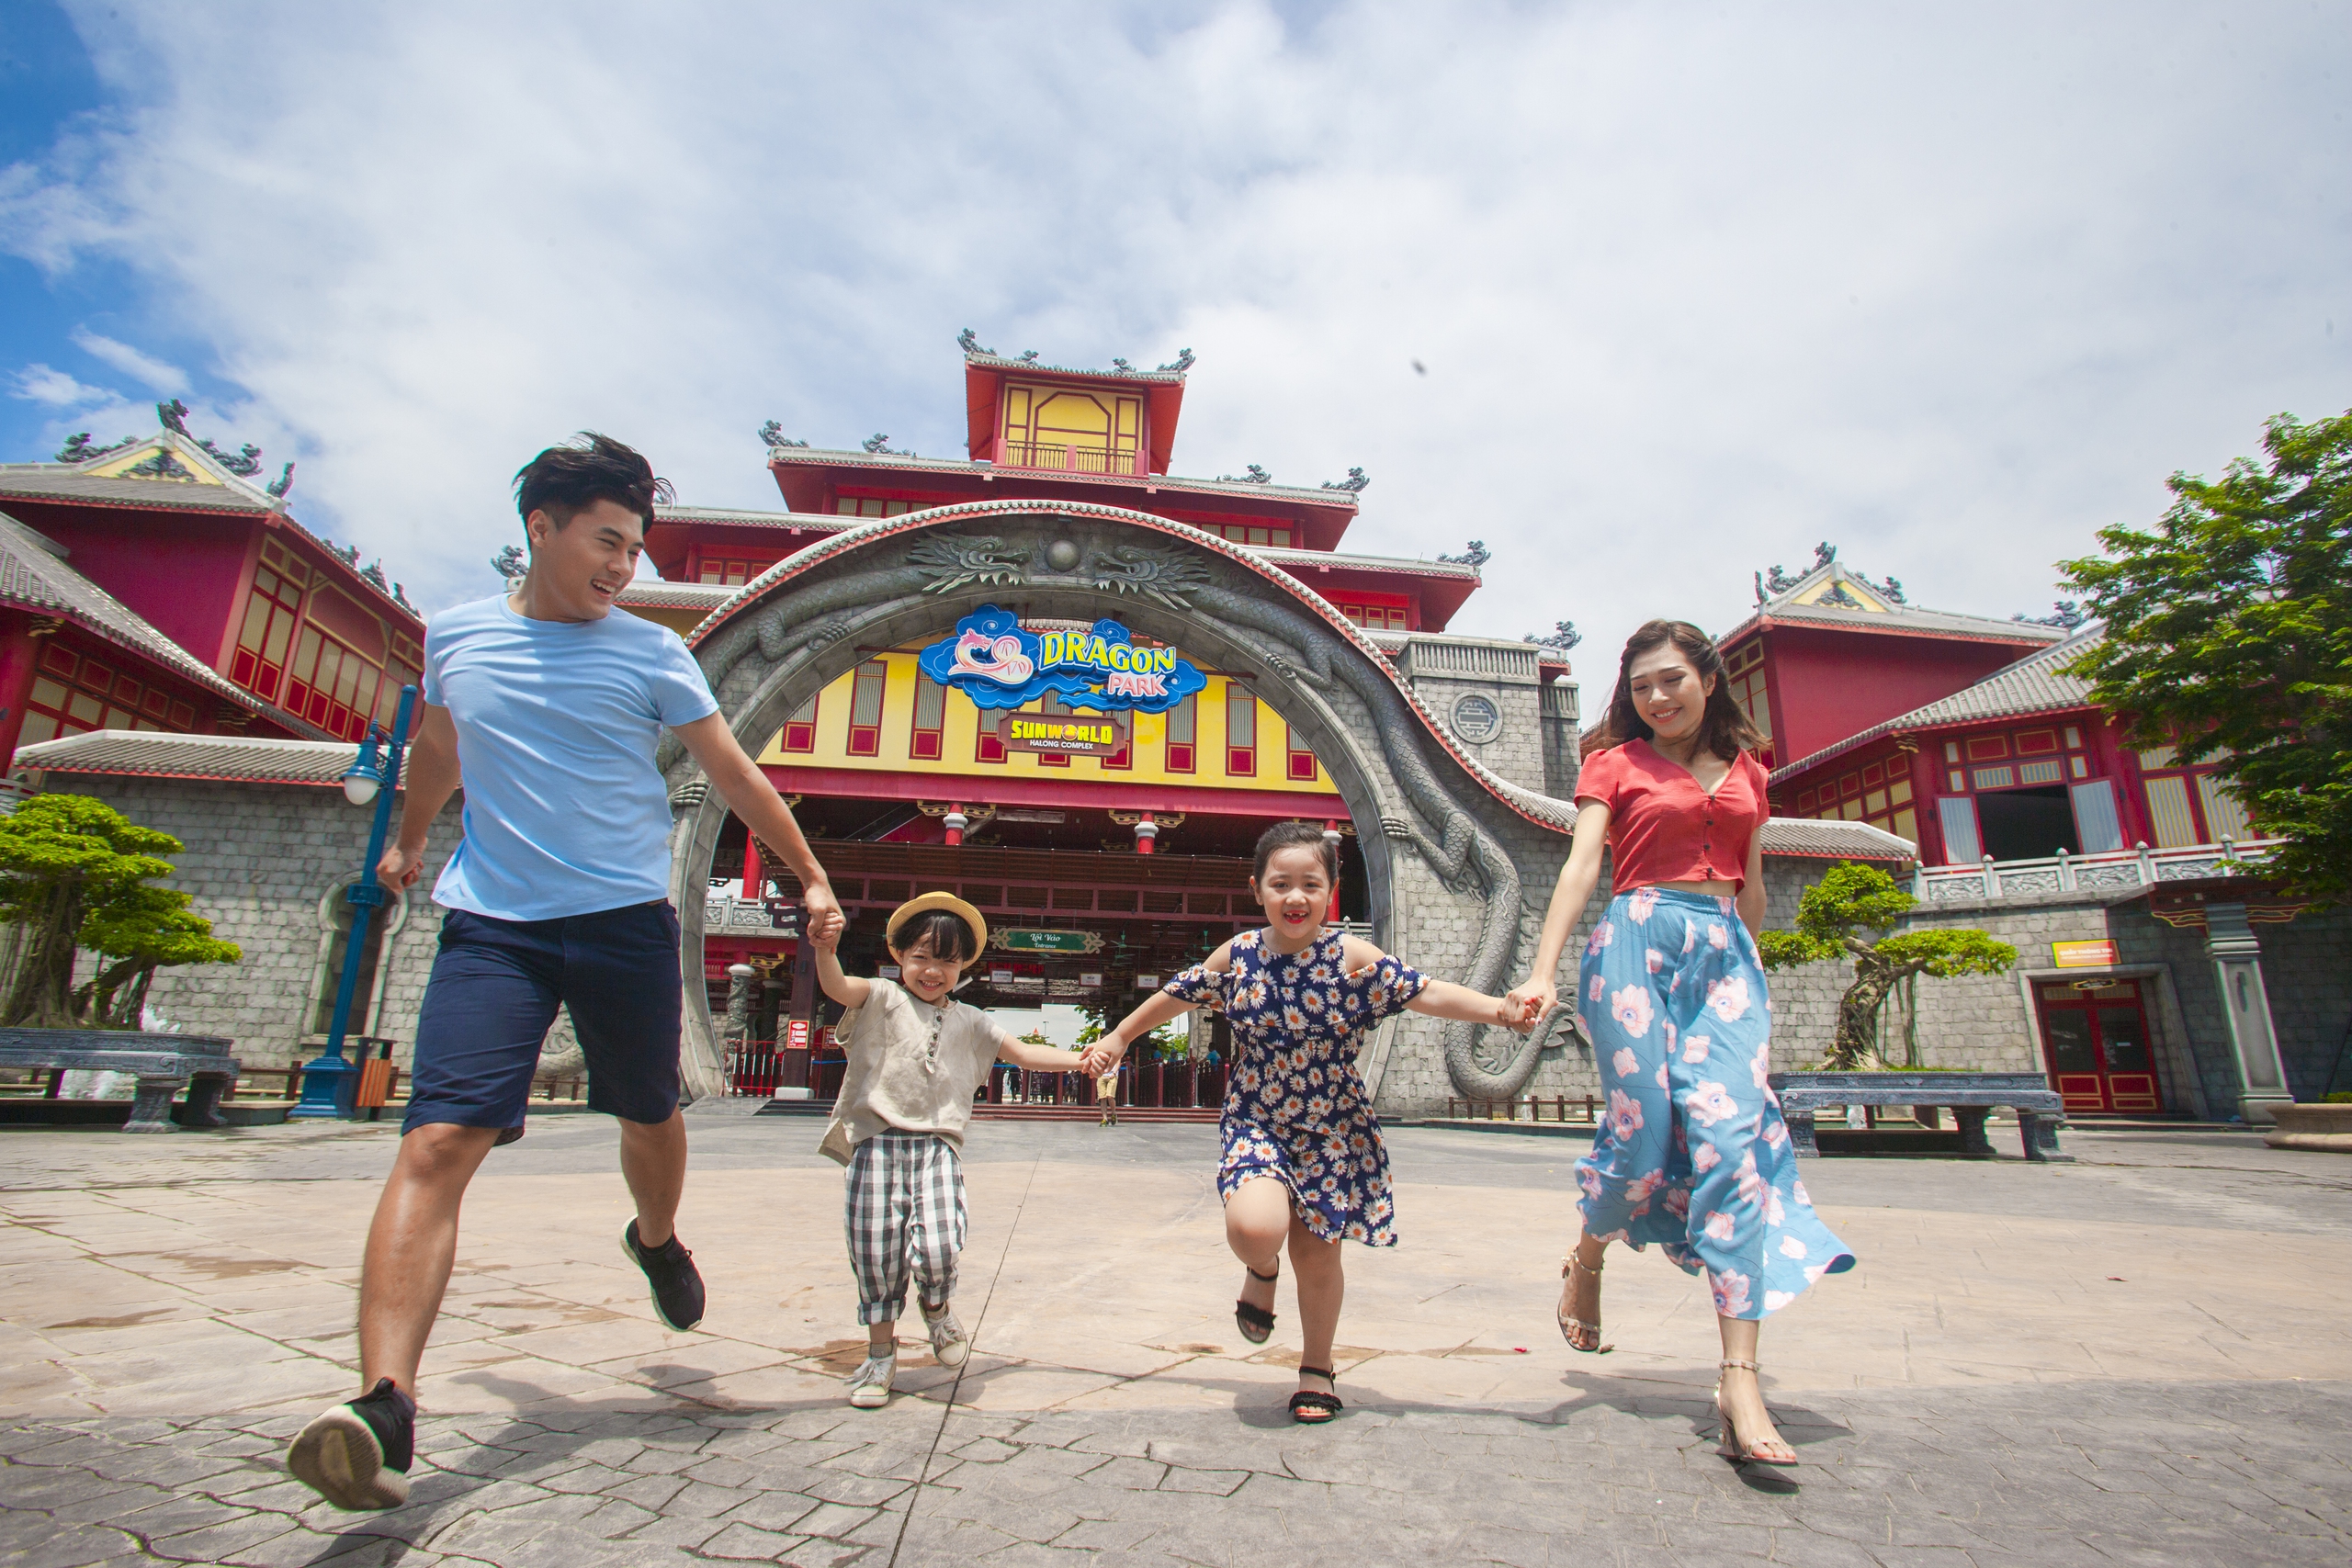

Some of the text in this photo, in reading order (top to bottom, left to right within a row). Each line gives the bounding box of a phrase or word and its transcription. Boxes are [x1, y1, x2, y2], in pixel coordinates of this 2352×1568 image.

[1041, 630, 1175, 674] DRAGON
[1108, 673, 1168, 696] PARK
[1029, 739, 1093, 750] HALONG COMPLEX
